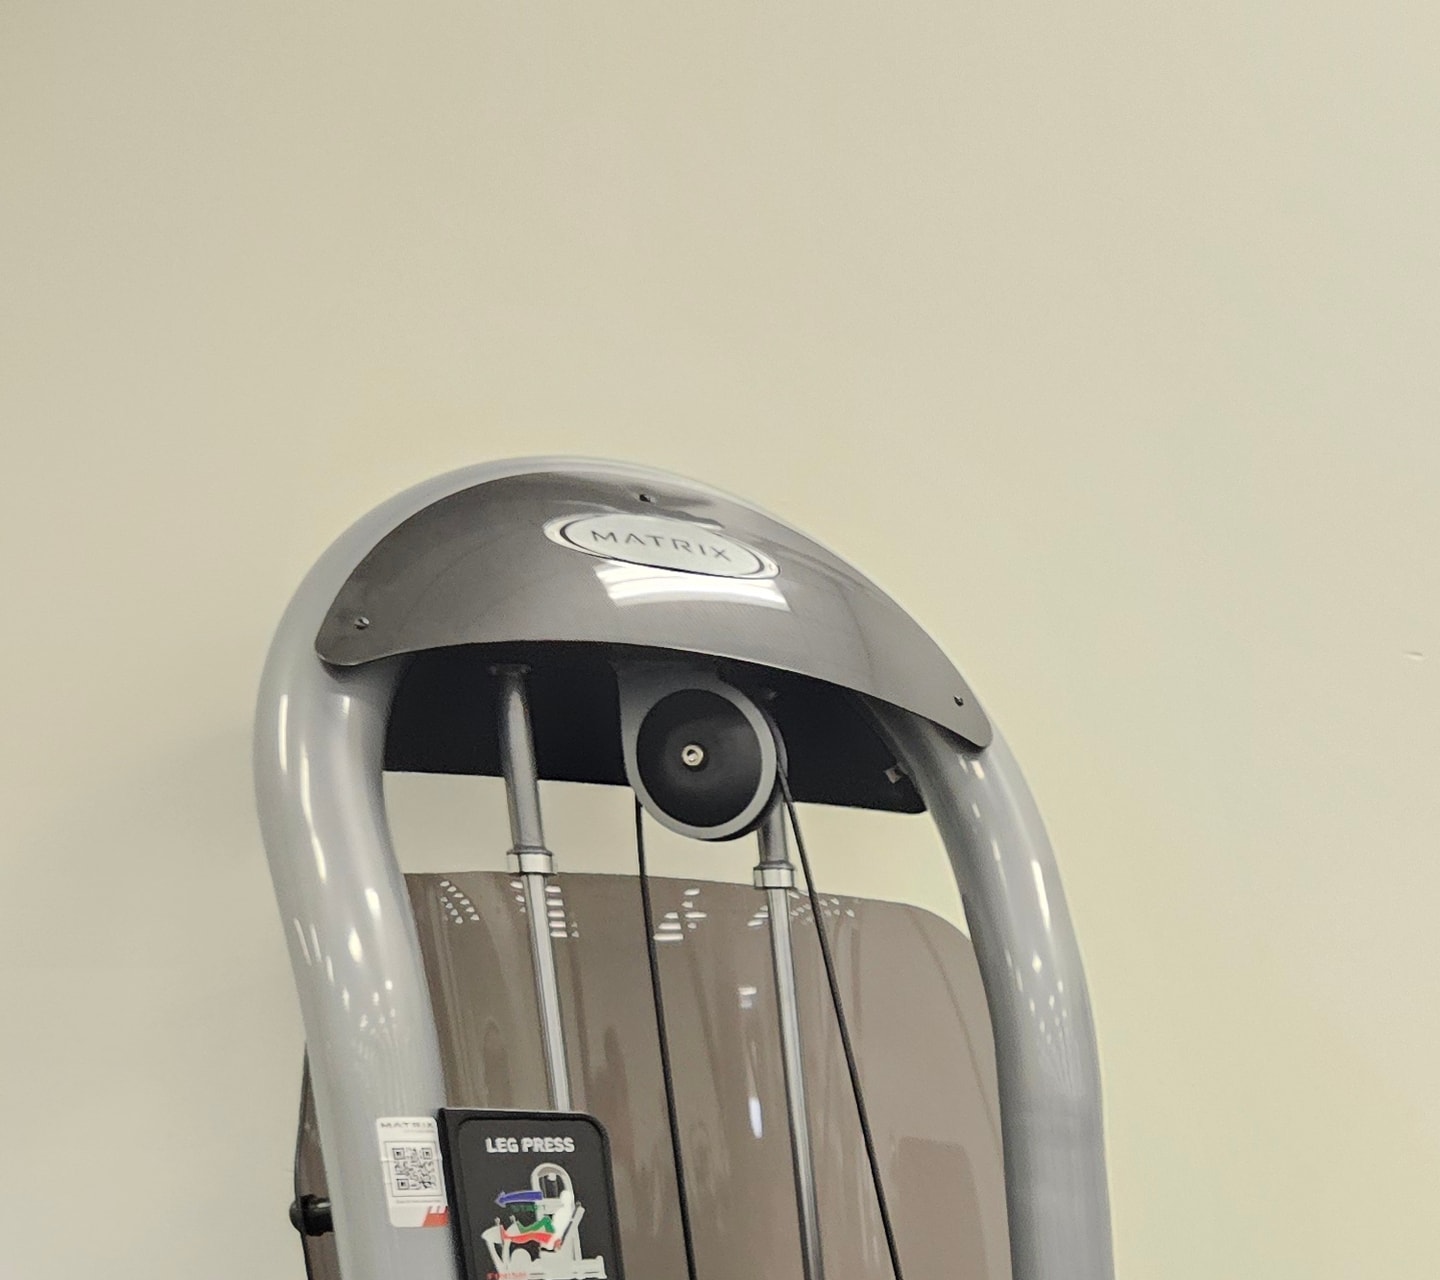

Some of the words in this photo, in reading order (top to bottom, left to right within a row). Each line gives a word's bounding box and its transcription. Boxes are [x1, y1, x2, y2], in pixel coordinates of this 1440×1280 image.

[591, 530, 731, 562] MATRIX
[485, 1137, 519, 1153] LEG
[520, 1136, 575, 1153] PRESS
